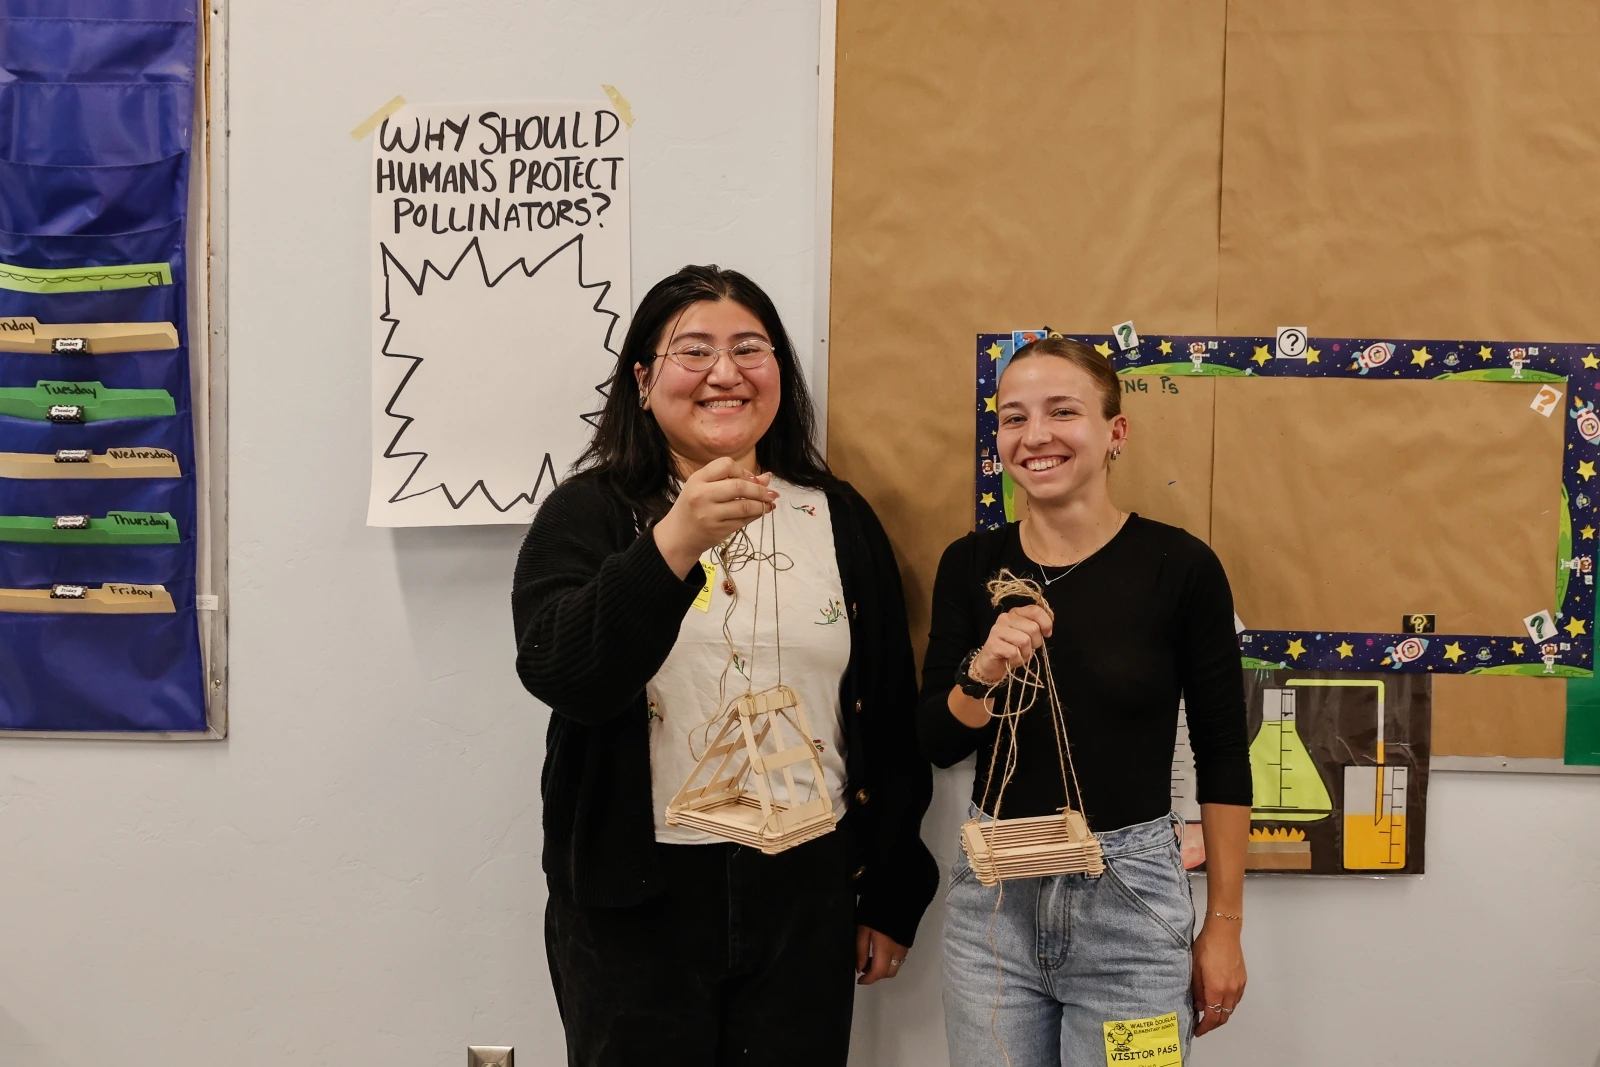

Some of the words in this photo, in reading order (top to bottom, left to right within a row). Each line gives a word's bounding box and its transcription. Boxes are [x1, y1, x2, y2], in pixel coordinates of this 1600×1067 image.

[380, 113, 470, 153] WHY
[479, 110, 620, 155] SHOULD
[377, 158, 498, 194] HUMANS
[509, 156, 624, 194] PROTECT
[394, 192, 611, 234] POLLINATORS?
[0, 319, 35, 335] nday
[40, 383, 97, 398] Tuesday
[1119, 378, 1148, 393] NG
[109, 450, 175, 463] Wednesday
[108, 514, 169, 529] Thursday
[109, 586, 153, 598] Friday
[1111, 1050, 1155, 1061] VISITOR
[1157, 1044, 1178, 1055] PASS
